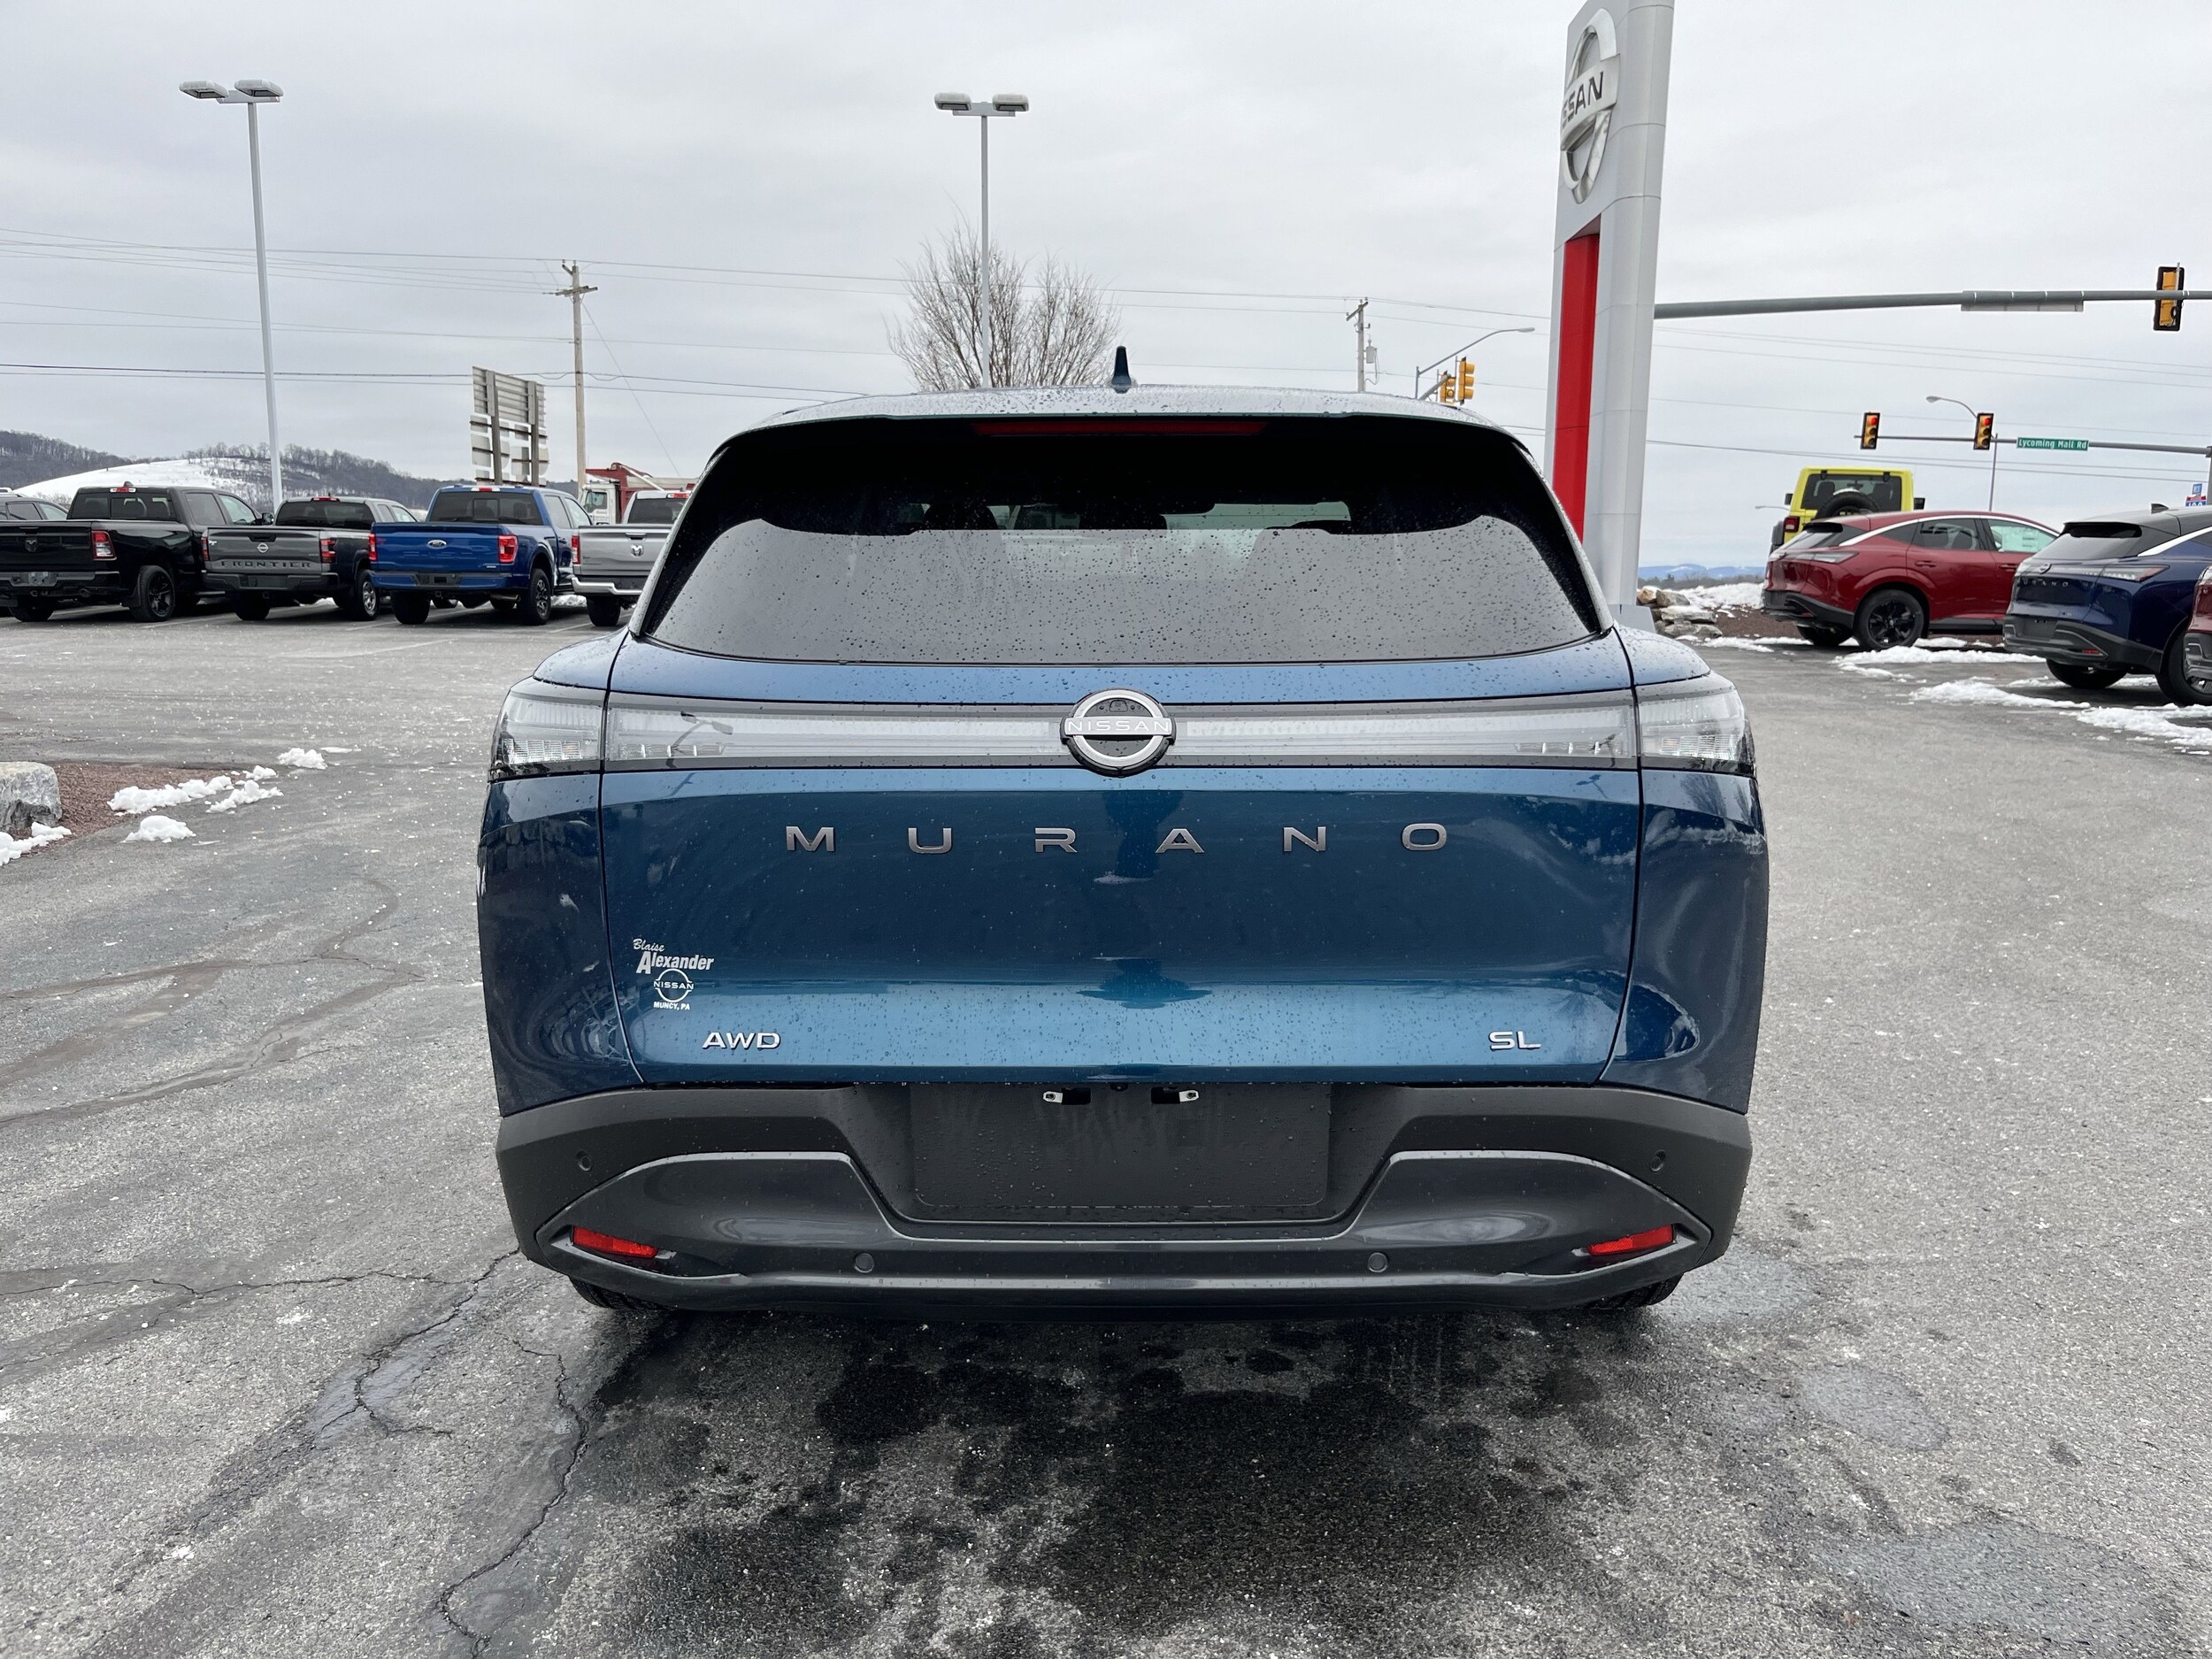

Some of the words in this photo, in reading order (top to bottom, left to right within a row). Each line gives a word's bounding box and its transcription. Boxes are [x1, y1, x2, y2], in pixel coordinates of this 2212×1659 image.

[2018, 438, 2055, 449] Lycoming
[2057, 440, 2074, 449] Mall
[2077, 441, 2087, 449] Rd
[1068, 720, 1169, 732] NISSAN
[785, 823, 1447, 854] MURANO
[633, 938, 664, 952] Blaise
[635, 951, 715, 974] Alexander
[653, 980, 695, 990] NISSAN
[653, 1001, 680, 1010] MUNCY,
[680, 1002, 690, 1010] PA
[702, 1032, 780, 1049] AWD
[1488, 1031, 1541, 1050] SL
